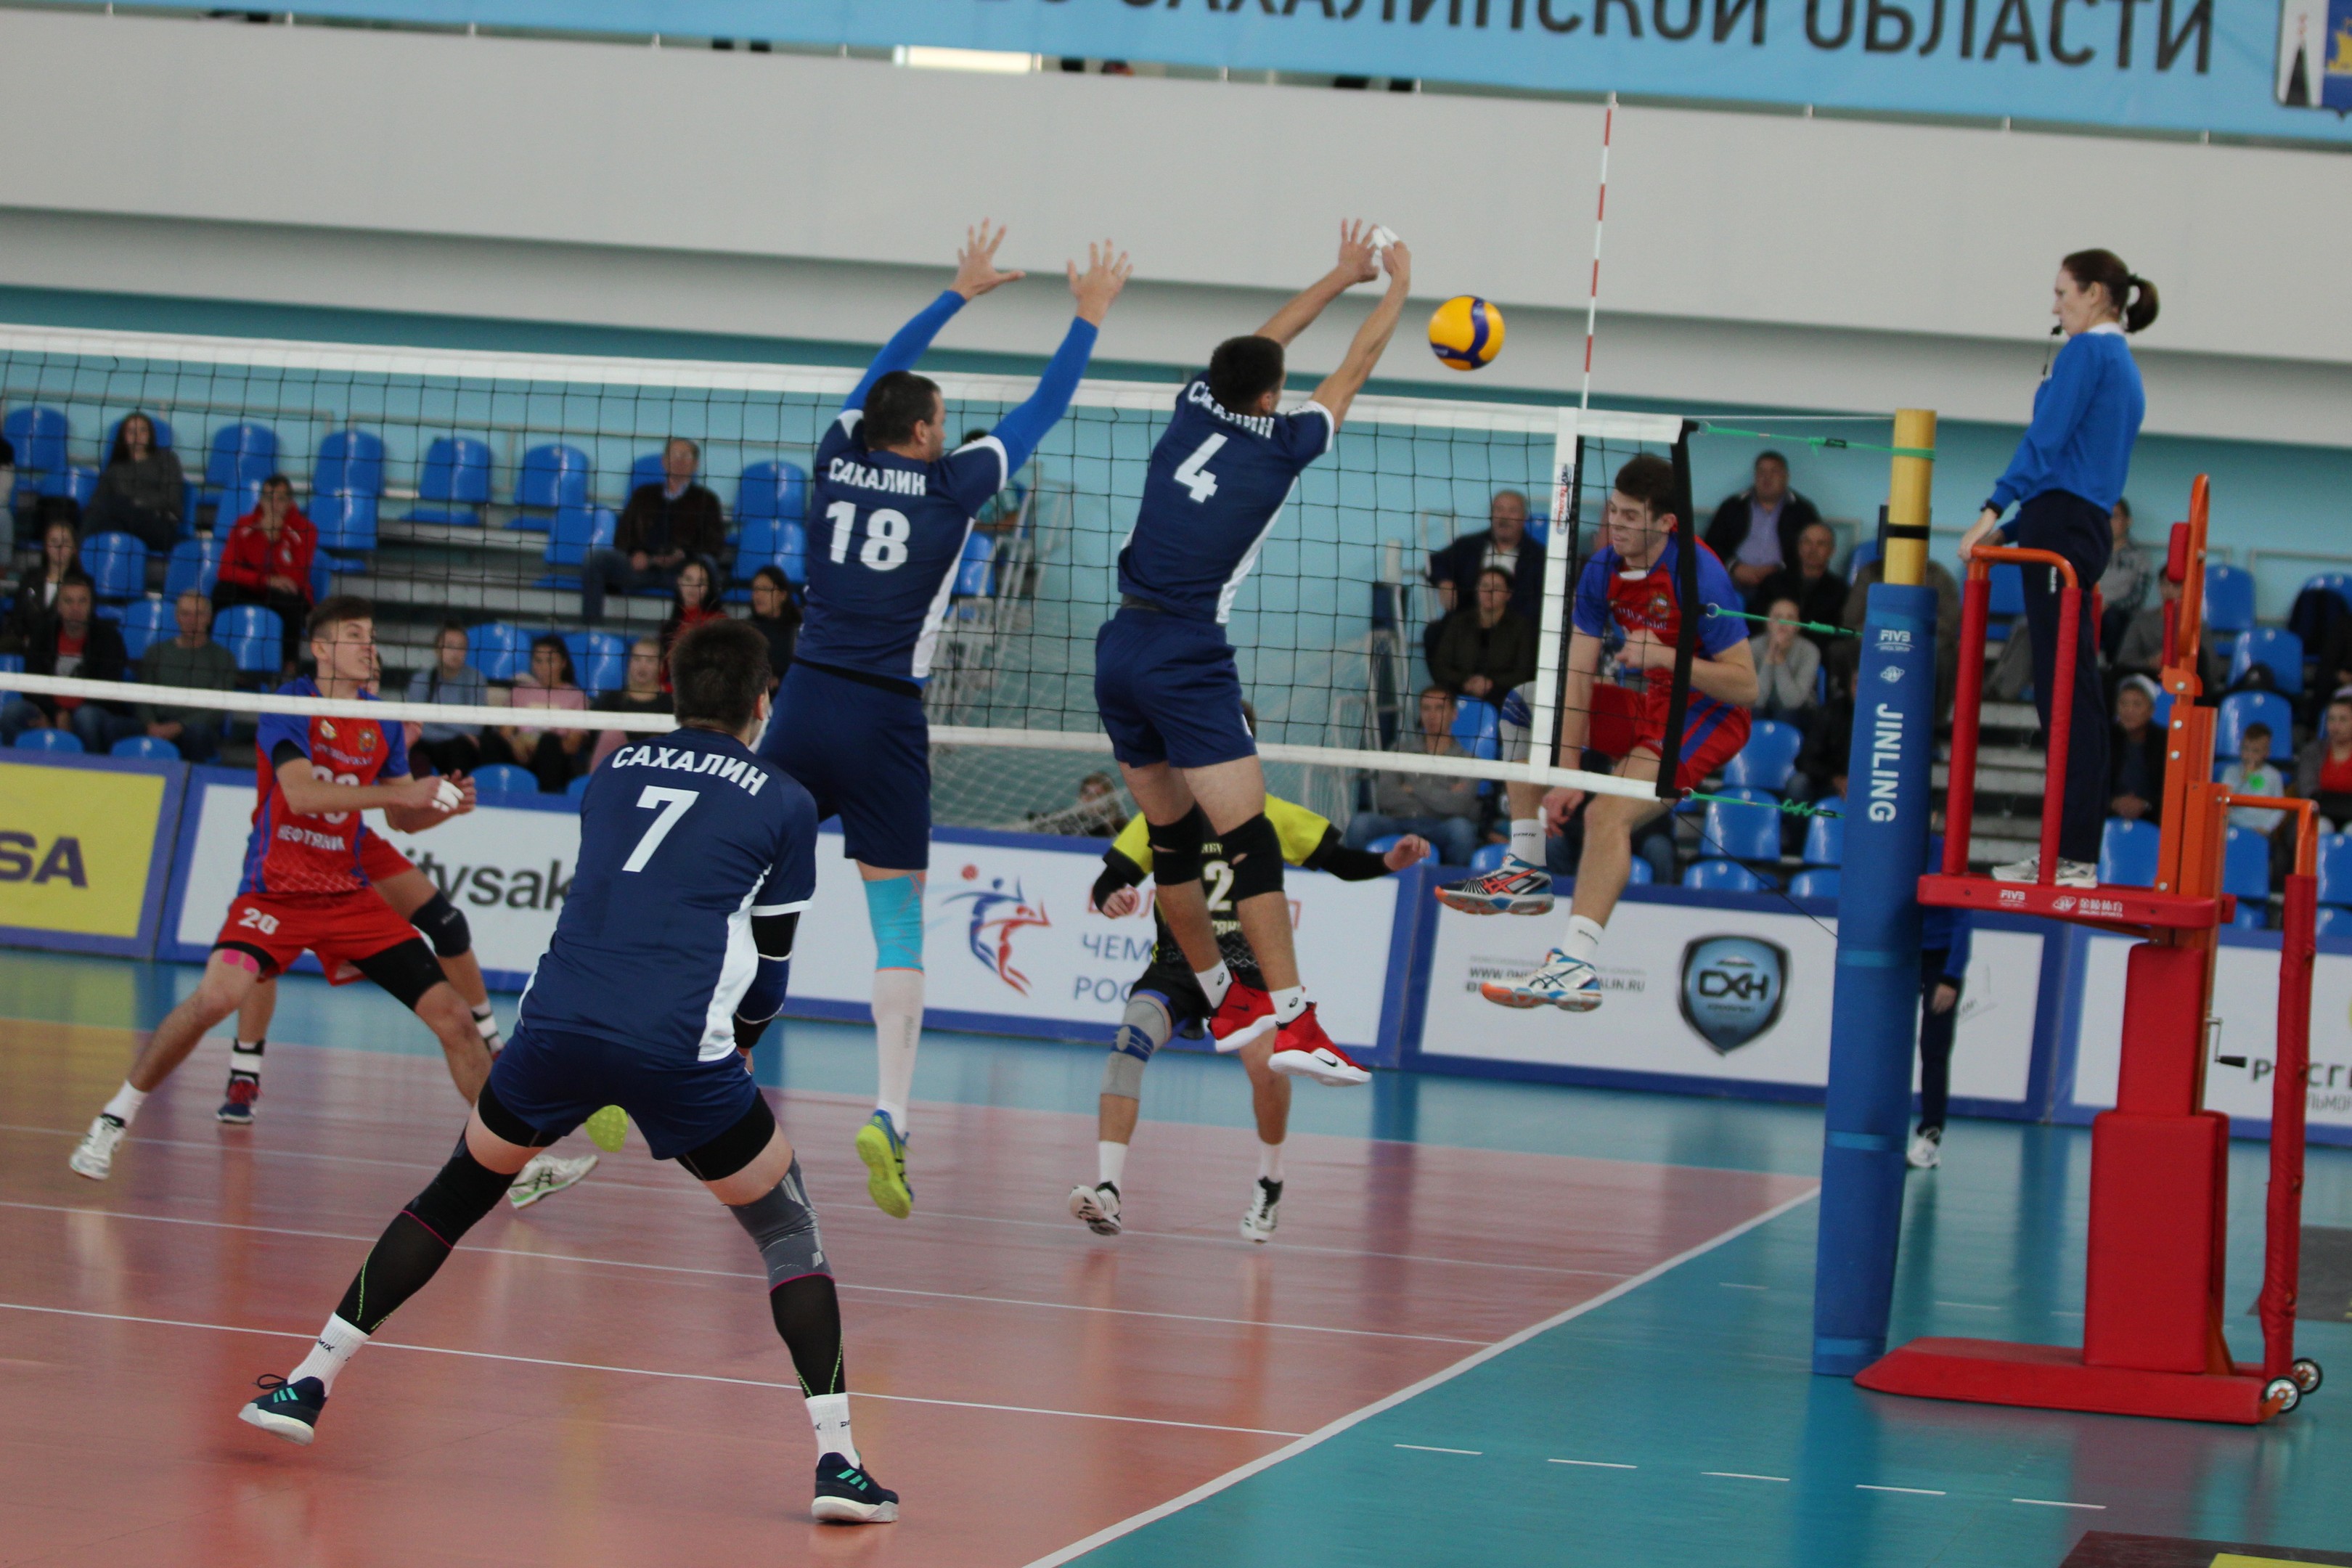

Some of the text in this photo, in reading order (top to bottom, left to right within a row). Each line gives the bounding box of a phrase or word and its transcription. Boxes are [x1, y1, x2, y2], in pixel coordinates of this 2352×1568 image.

[828, 457, 926, 496] САХАЛИН
[1174, 433, 1228, 503] 4
[826, 500, 911, 571] 18
[1880, 629, 1911, 642] FIVB
[611, 745, 769, 796] САХАЛИН
[1869, 703, 1904, 822] JINLING
[621, 785, 701, 873] 7
[1203, 859, 1235, 911] 2
